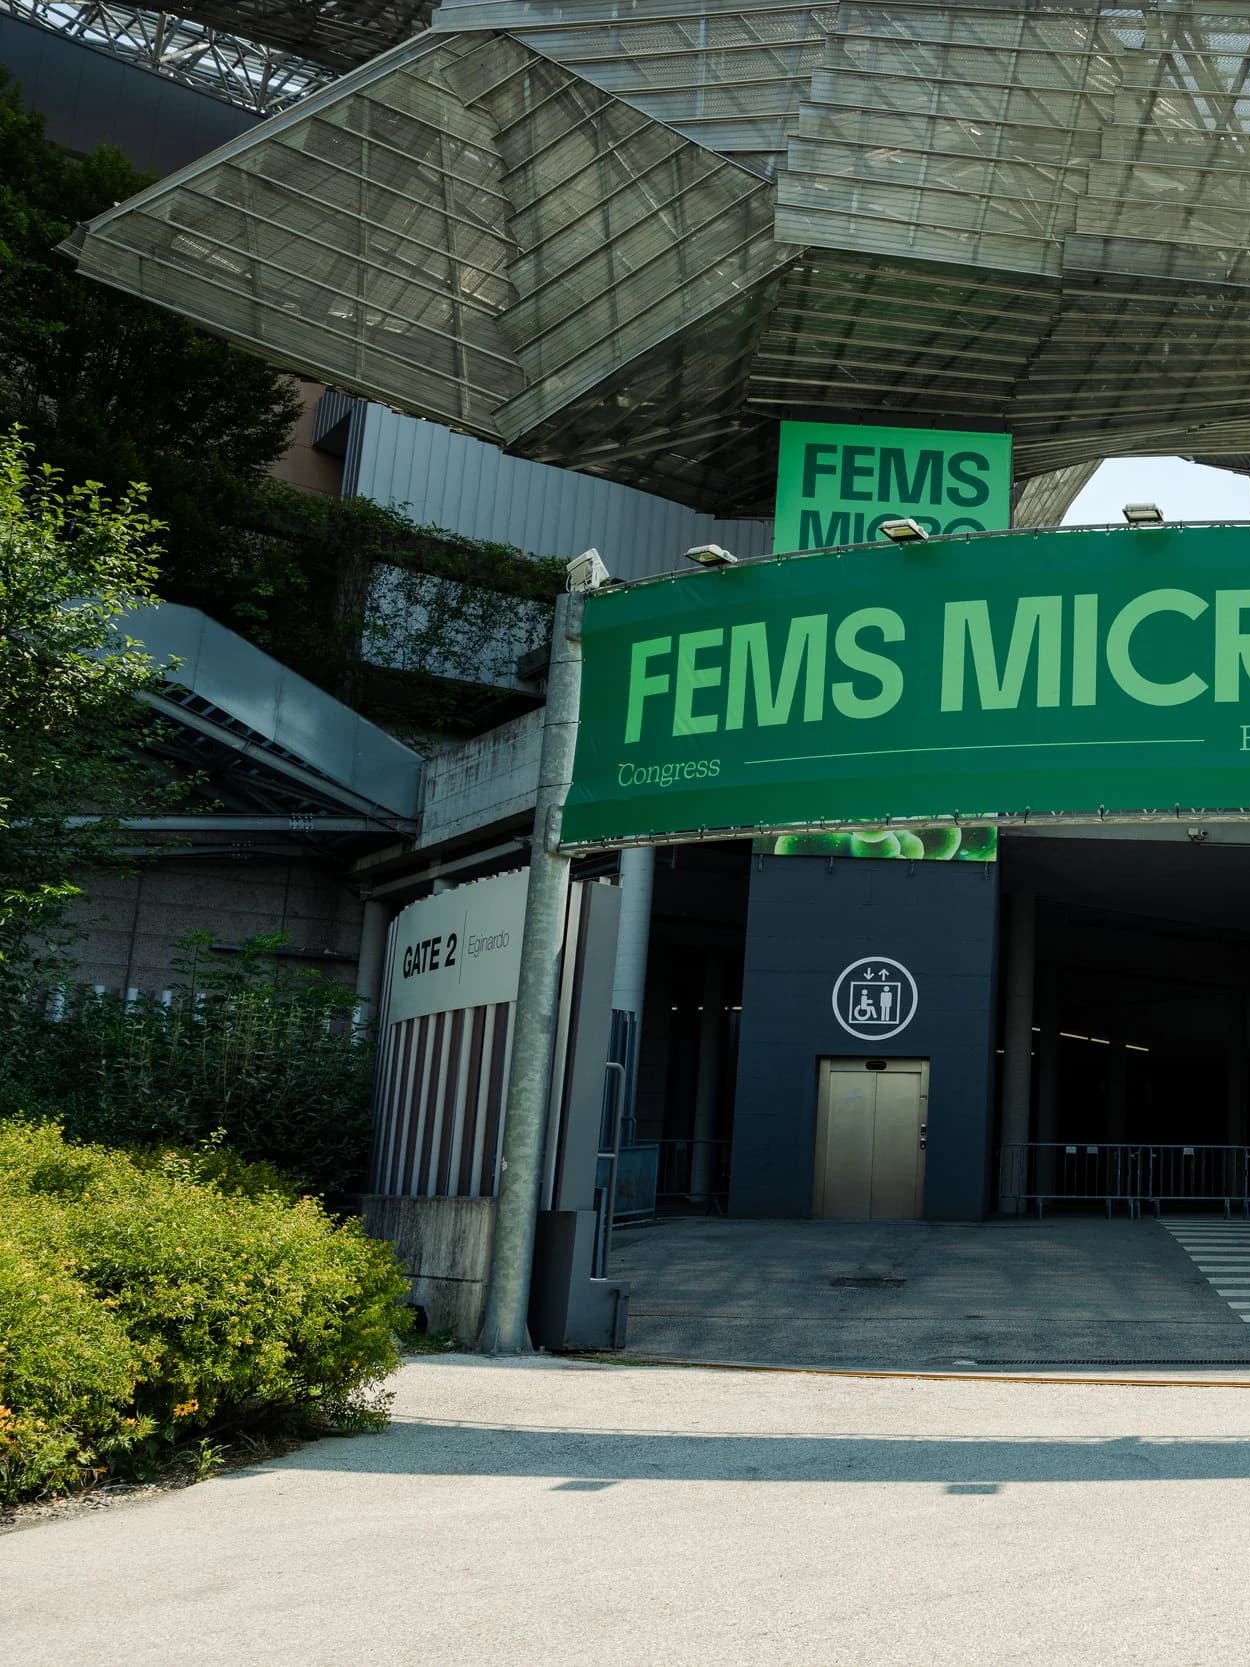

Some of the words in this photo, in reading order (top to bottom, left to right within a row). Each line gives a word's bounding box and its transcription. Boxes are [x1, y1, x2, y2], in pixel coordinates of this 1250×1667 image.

[802, 443, 990, 507] FEMS
[624, 607, 905, 744] FEMS
[617, 759, 721, 787] Congress
[403, 936, 441, 979] GATE
[445, 933, 457, 967] 2
[468, 929, 510, 958] Eginardo
